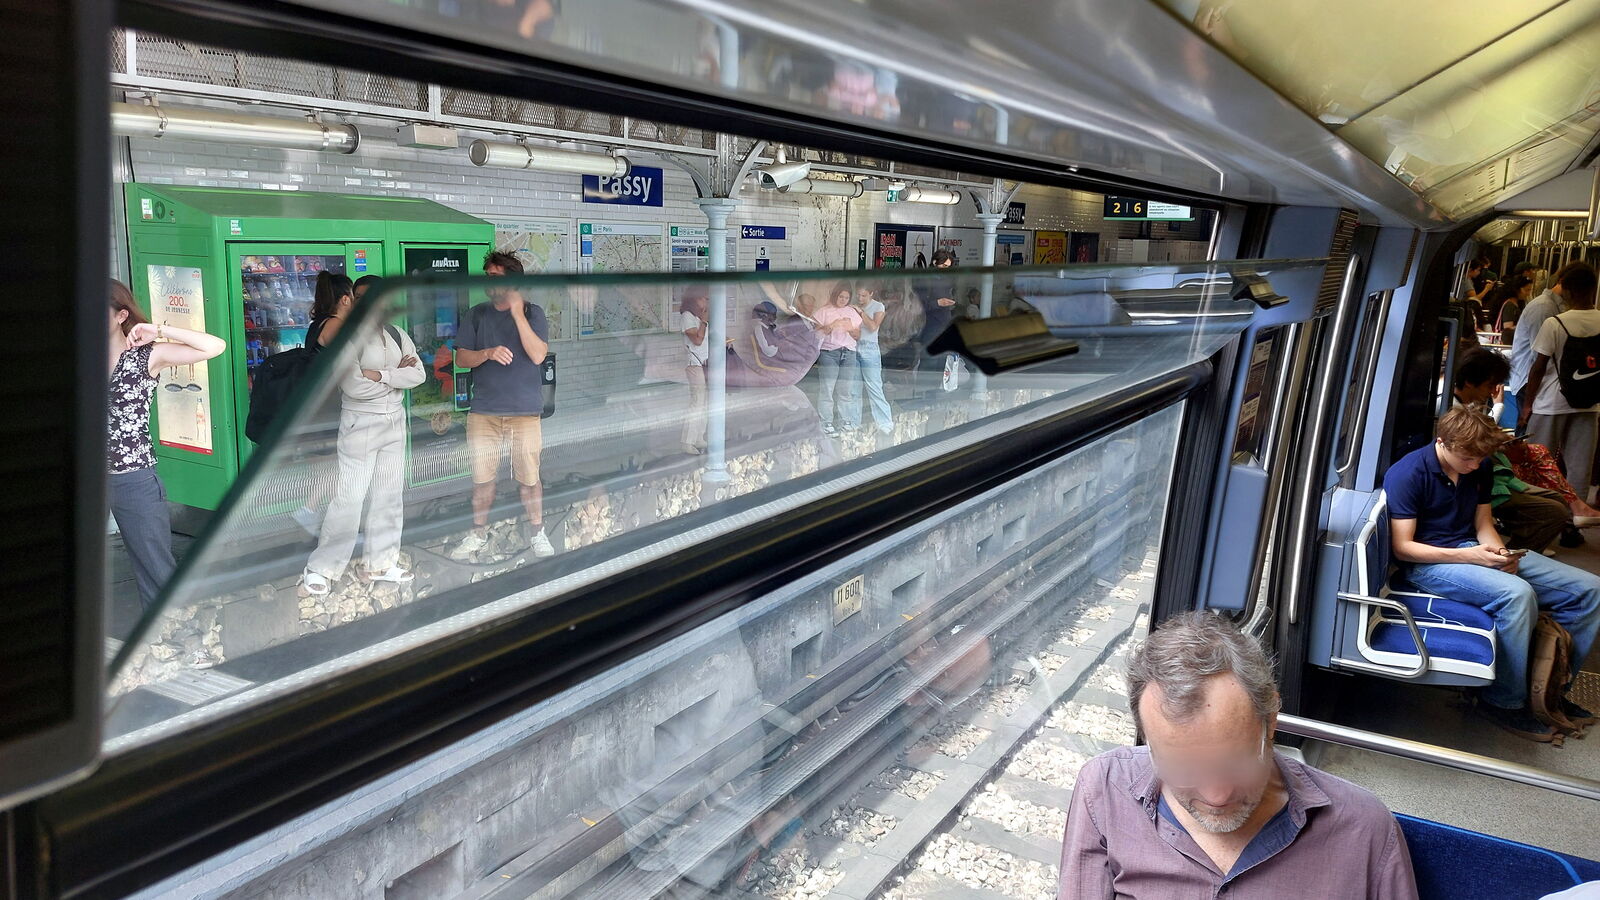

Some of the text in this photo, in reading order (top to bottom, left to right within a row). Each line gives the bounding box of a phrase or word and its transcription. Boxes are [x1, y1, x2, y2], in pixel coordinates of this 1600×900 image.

[598, 174, 652, 204] Passy
[1113, 202, 1142, 213] 2 6
[1007, 207, 1023, 222] assy
[749, 228, 765, 238] Sortie
[760, 246, 766, 256] 5
[432, 257, 460, 268] LAVAZZA
[169, 295, 185, 307] 200
